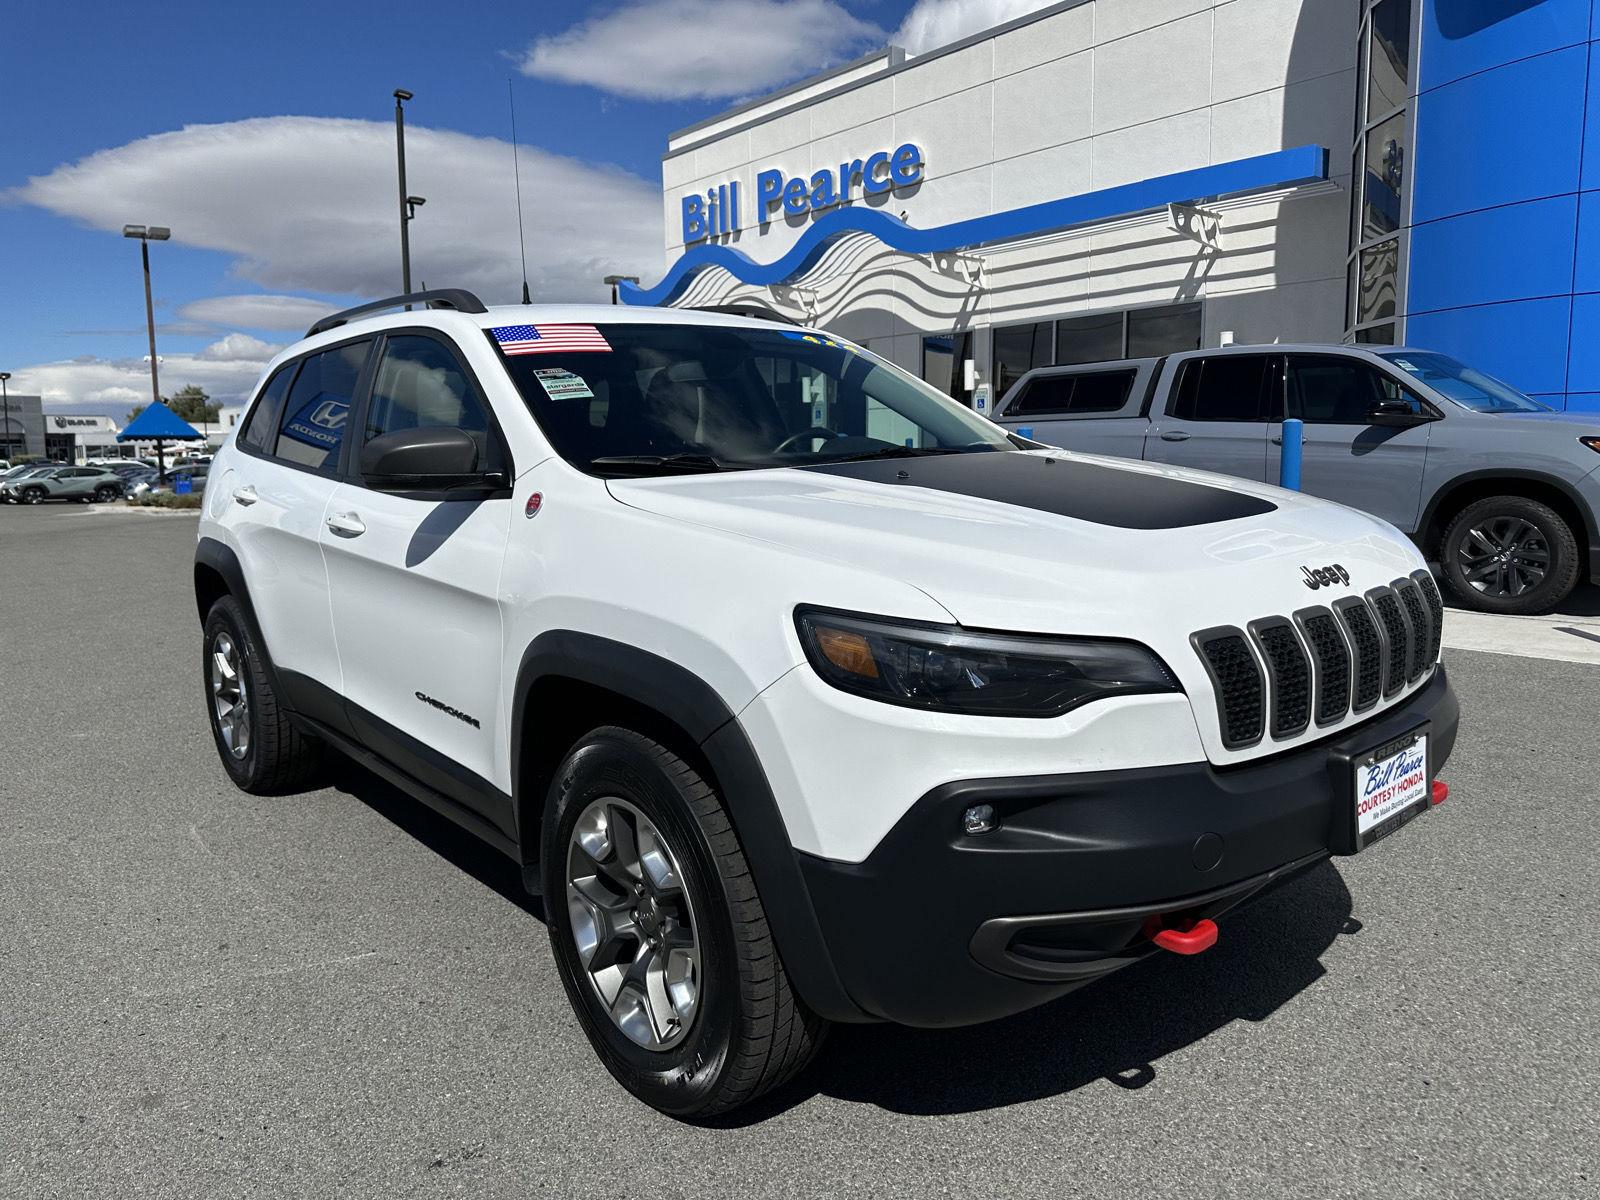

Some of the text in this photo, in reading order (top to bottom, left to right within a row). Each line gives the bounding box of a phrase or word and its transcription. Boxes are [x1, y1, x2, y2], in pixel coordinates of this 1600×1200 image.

[682, 143, 922, 244] Bill Pearce
[1300, 564, 1349, 590] Jeep
[415, 691, 480, 730] CHEROKEE
[1378, 737, 1411, 759] RENO
[1357, 771, 1424, 817] COURTESY HONDA
[1364, 751, 1423, 797] Bill Pearce
